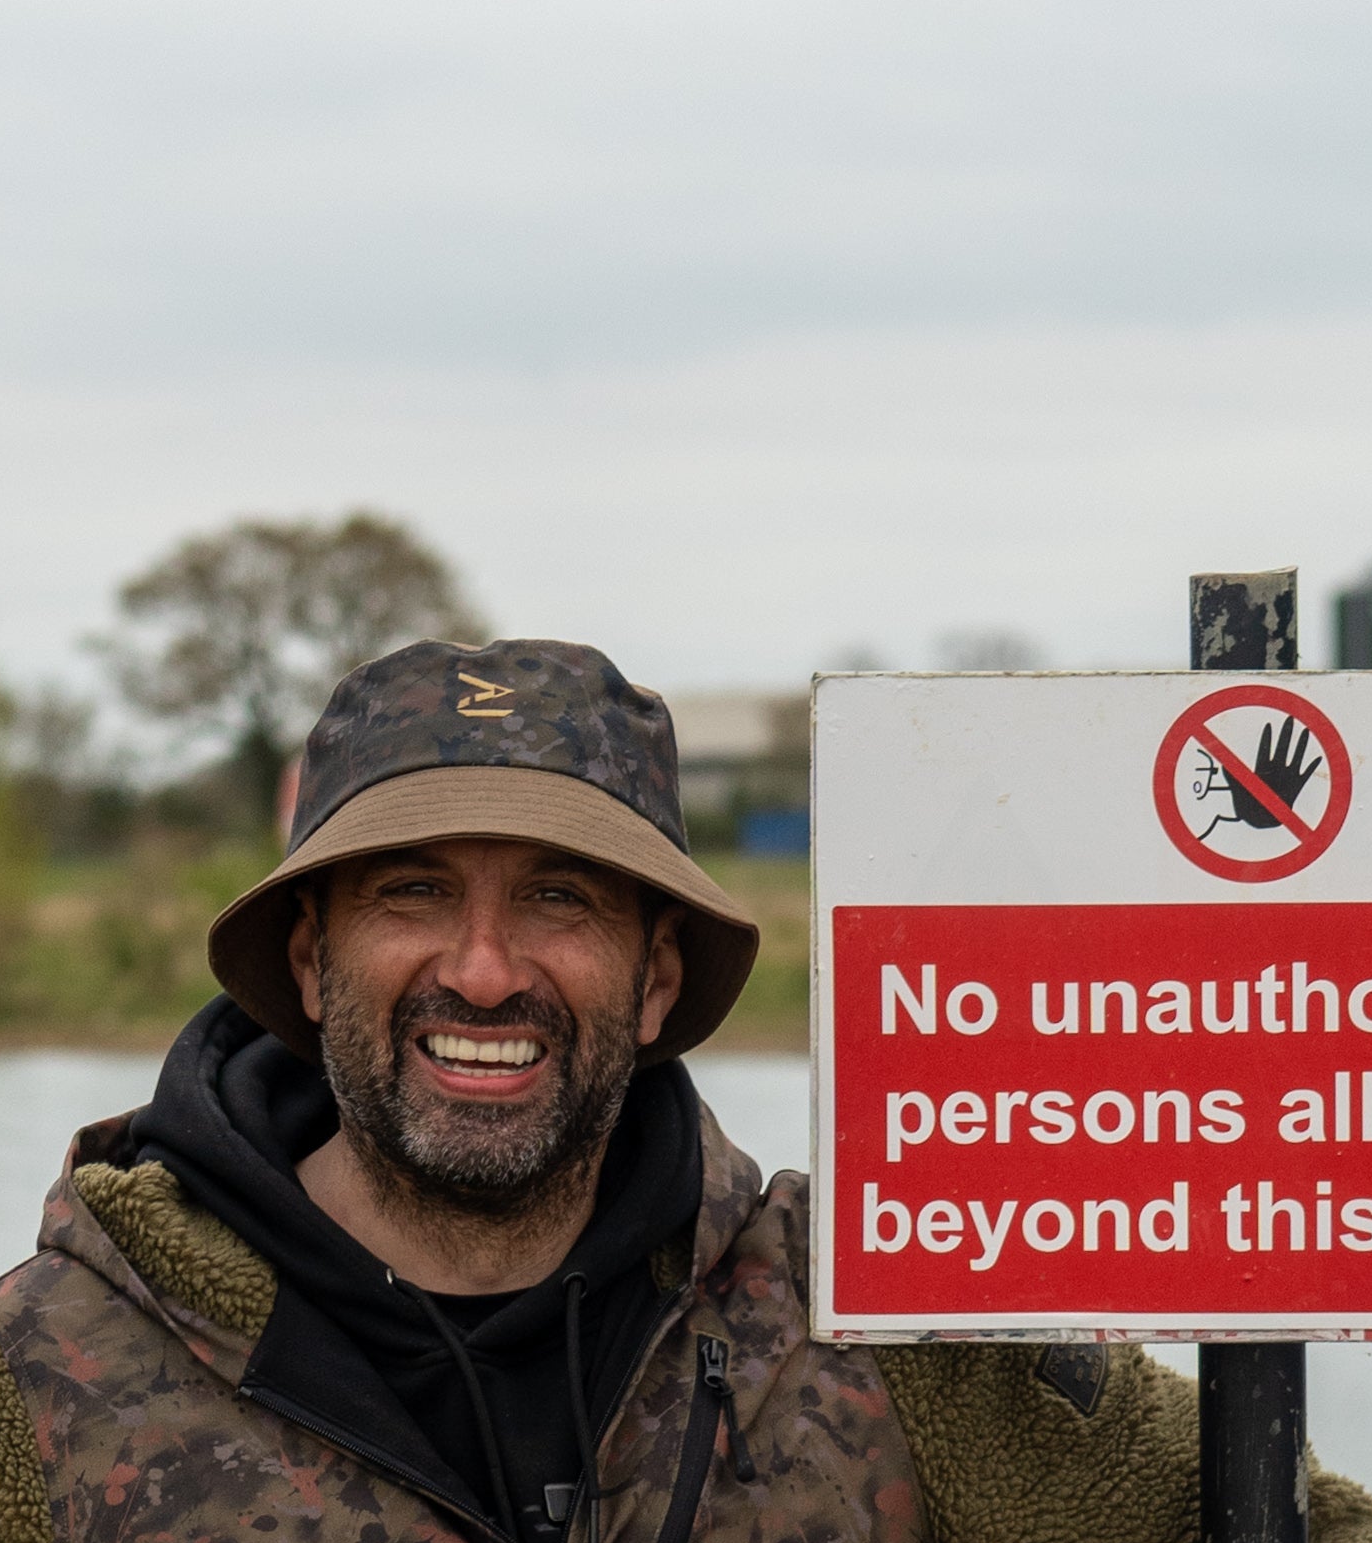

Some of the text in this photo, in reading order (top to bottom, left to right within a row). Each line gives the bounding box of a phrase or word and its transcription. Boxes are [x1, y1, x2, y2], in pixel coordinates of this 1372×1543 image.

[881, 964, 998, 1035] No
[886, 1089, 1246, 1162] persons
[862, 1181, 1189, 1271] beyond
